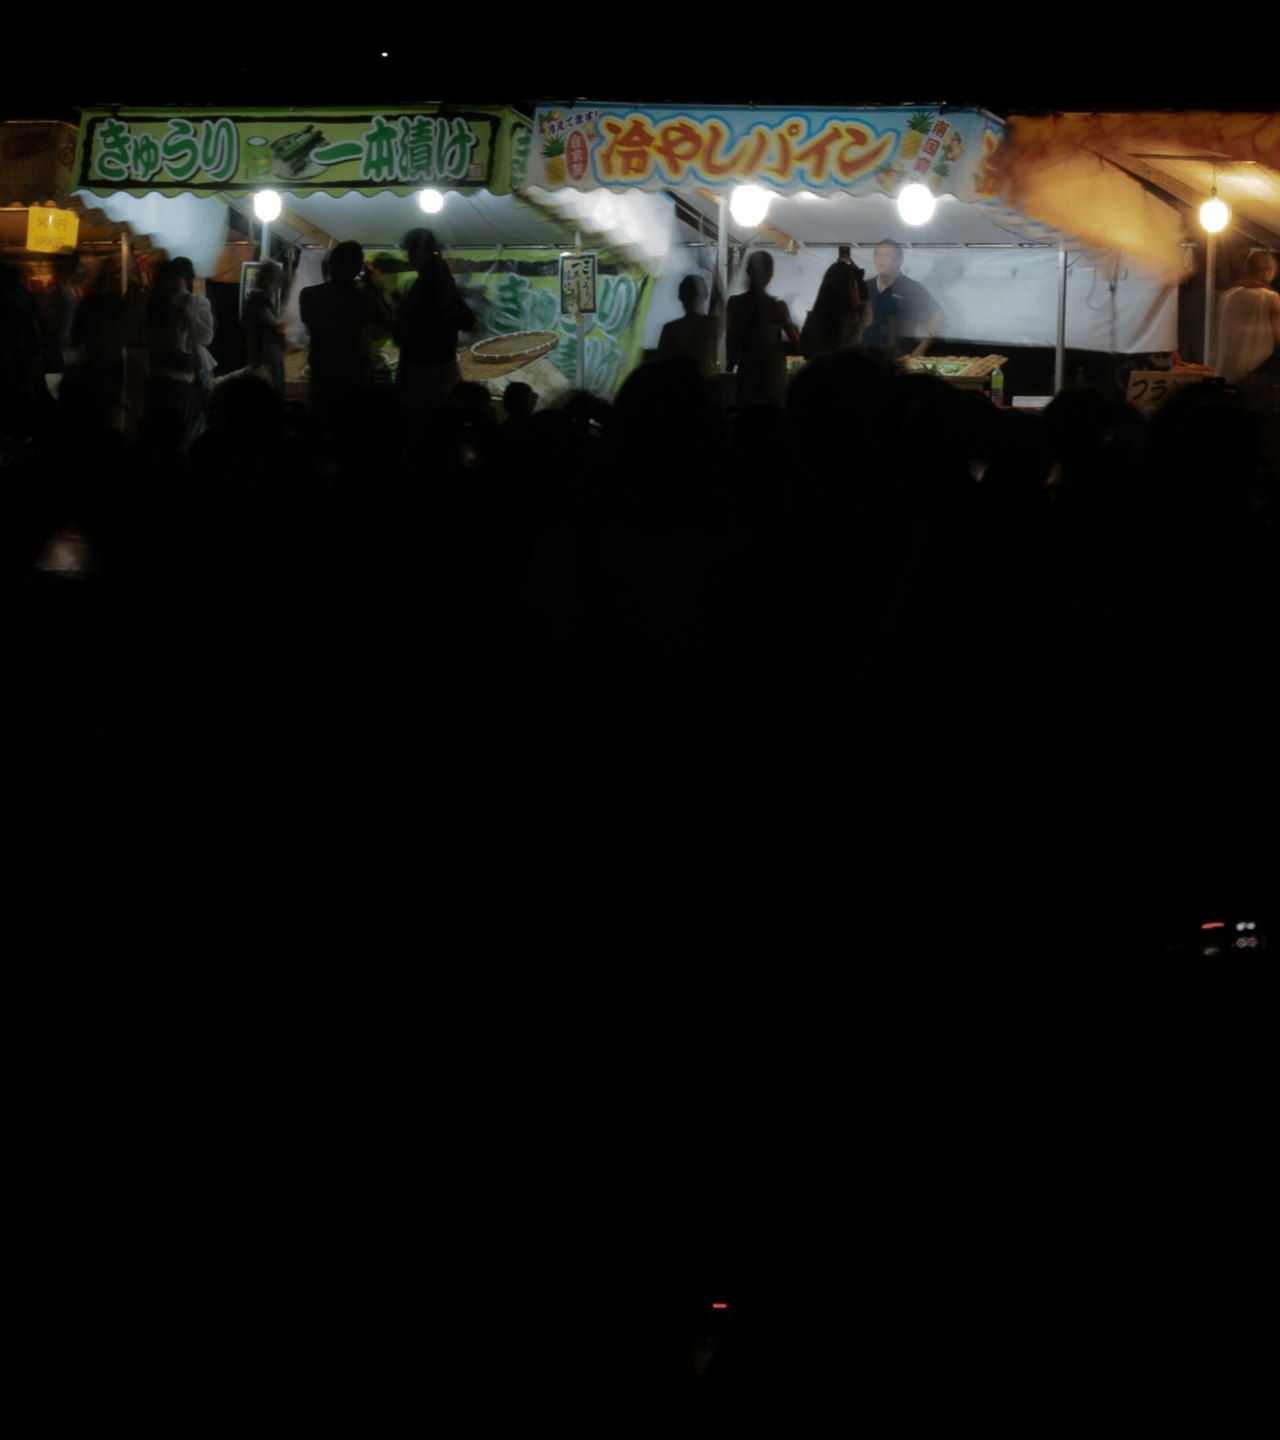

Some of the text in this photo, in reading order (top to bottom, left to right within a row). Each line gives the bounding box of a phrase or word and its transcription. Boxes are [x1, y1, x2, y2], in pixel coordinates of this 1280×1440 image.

[97, 117, 239, 182] きゅうり
[310, 116, 476, 182] 一本漬け
[598, 116, 897, 182] 冷やしパイン
